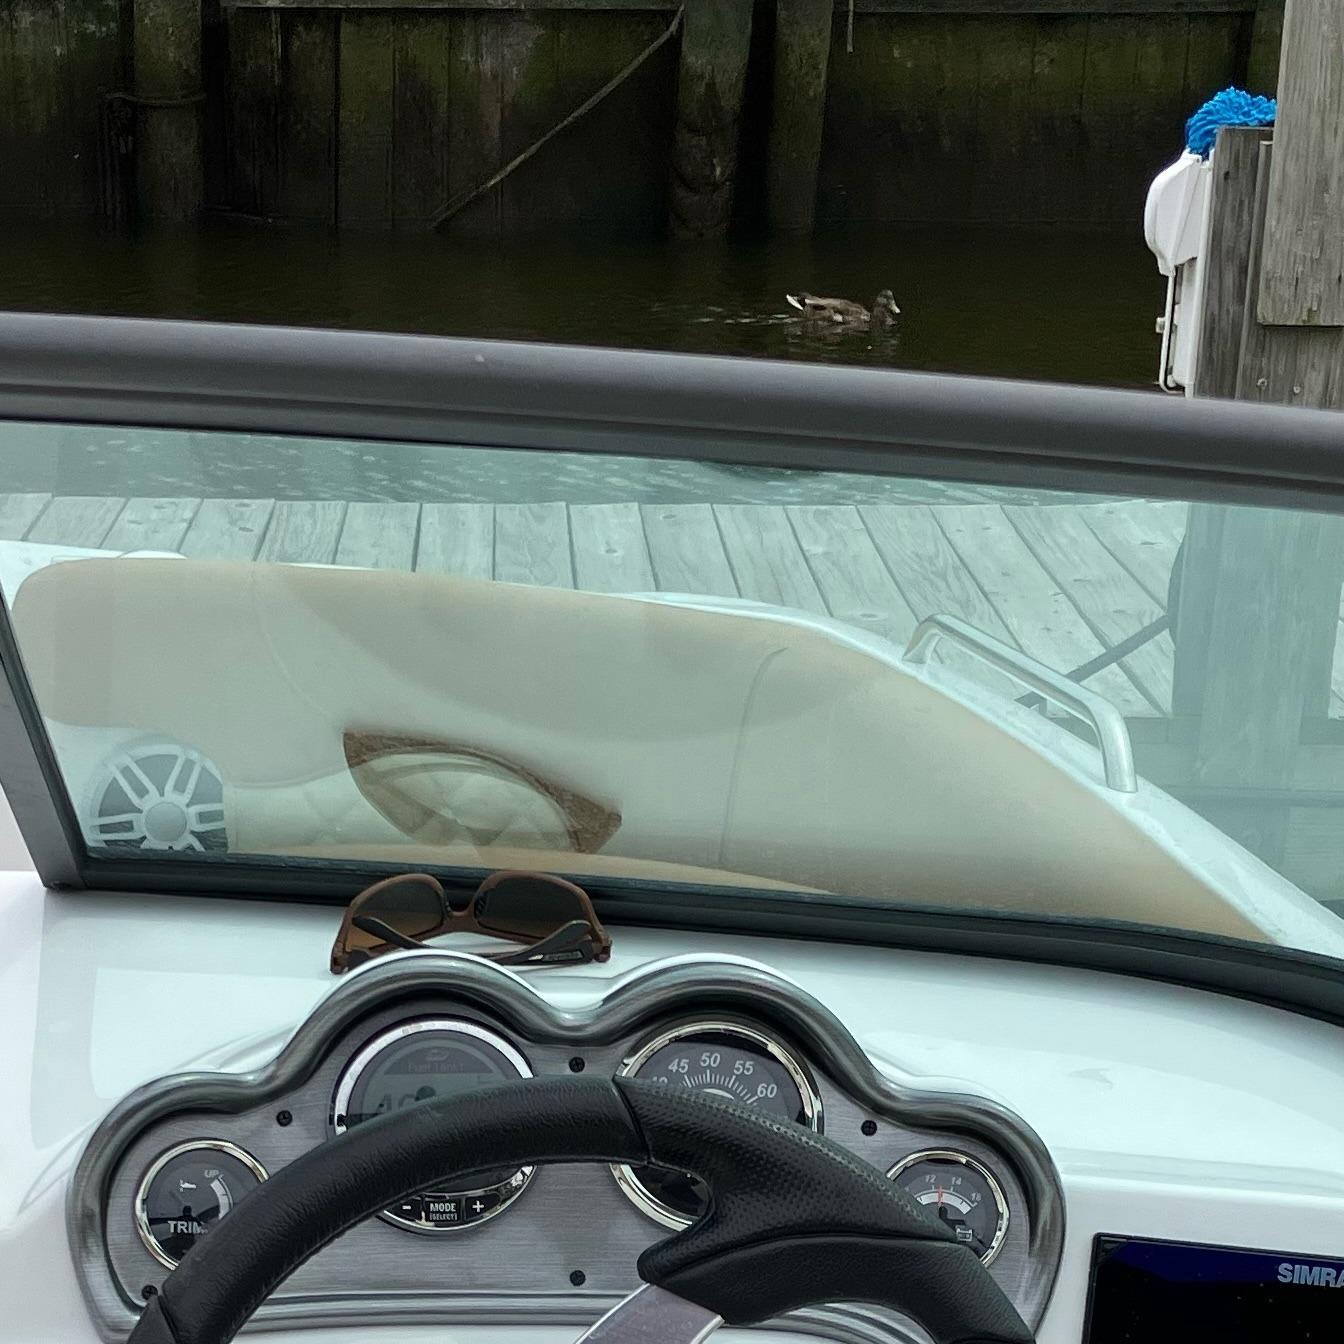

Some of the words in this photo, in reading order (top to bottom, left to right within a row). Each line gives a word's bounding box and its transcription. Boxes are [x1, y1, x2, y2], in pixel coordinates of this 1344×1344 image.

[668, 1058, 689, 1074] 45
[700, 1053, 721, 1067] 50
[733, 1061, 754, 1075] 55
[757, 1083, 777, 1098] 60
[203, 1169, 219, 1179] UP
[925, 1175, 936, 1183] 12
[951, 1177, 962, 1185] 14
[429, 1203, 457, 1212] MODE
